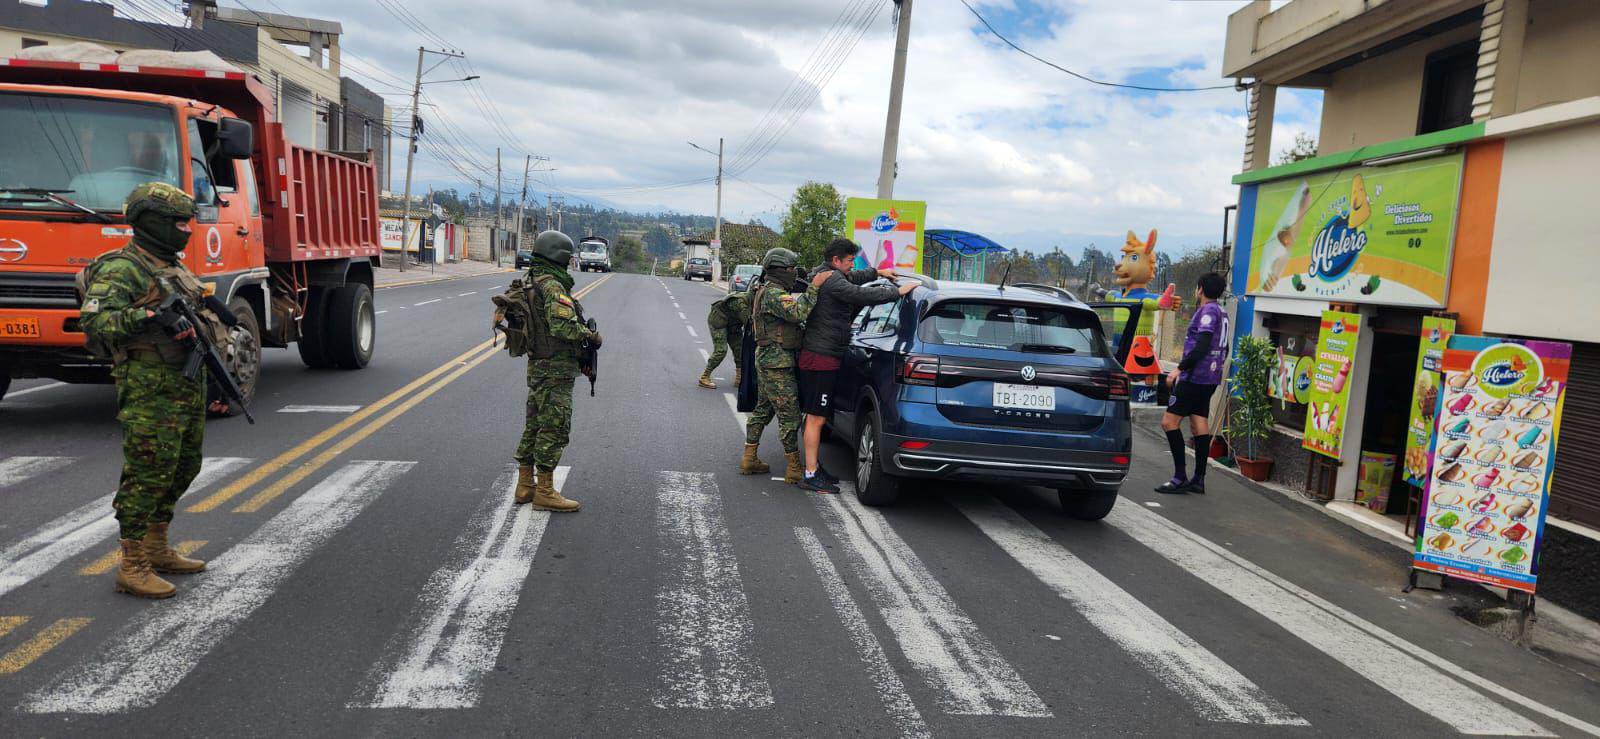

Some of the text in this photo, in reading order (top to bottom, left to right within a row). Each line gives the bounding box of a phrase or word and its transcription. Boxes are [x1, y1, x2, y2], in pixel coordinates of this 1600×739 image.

[1385, 204, 1420, 214] Deliciosos
[1394, 213, 1432, 225] Divertidos
[1309, 225, 1367, 277] Hielero
[0, 323, 37, 335] -0381
[1481, 368, 1525, 384] Hielero
[820, 394, 828, 406] 5
[997, 392, 1053, 407] TBI-2090
